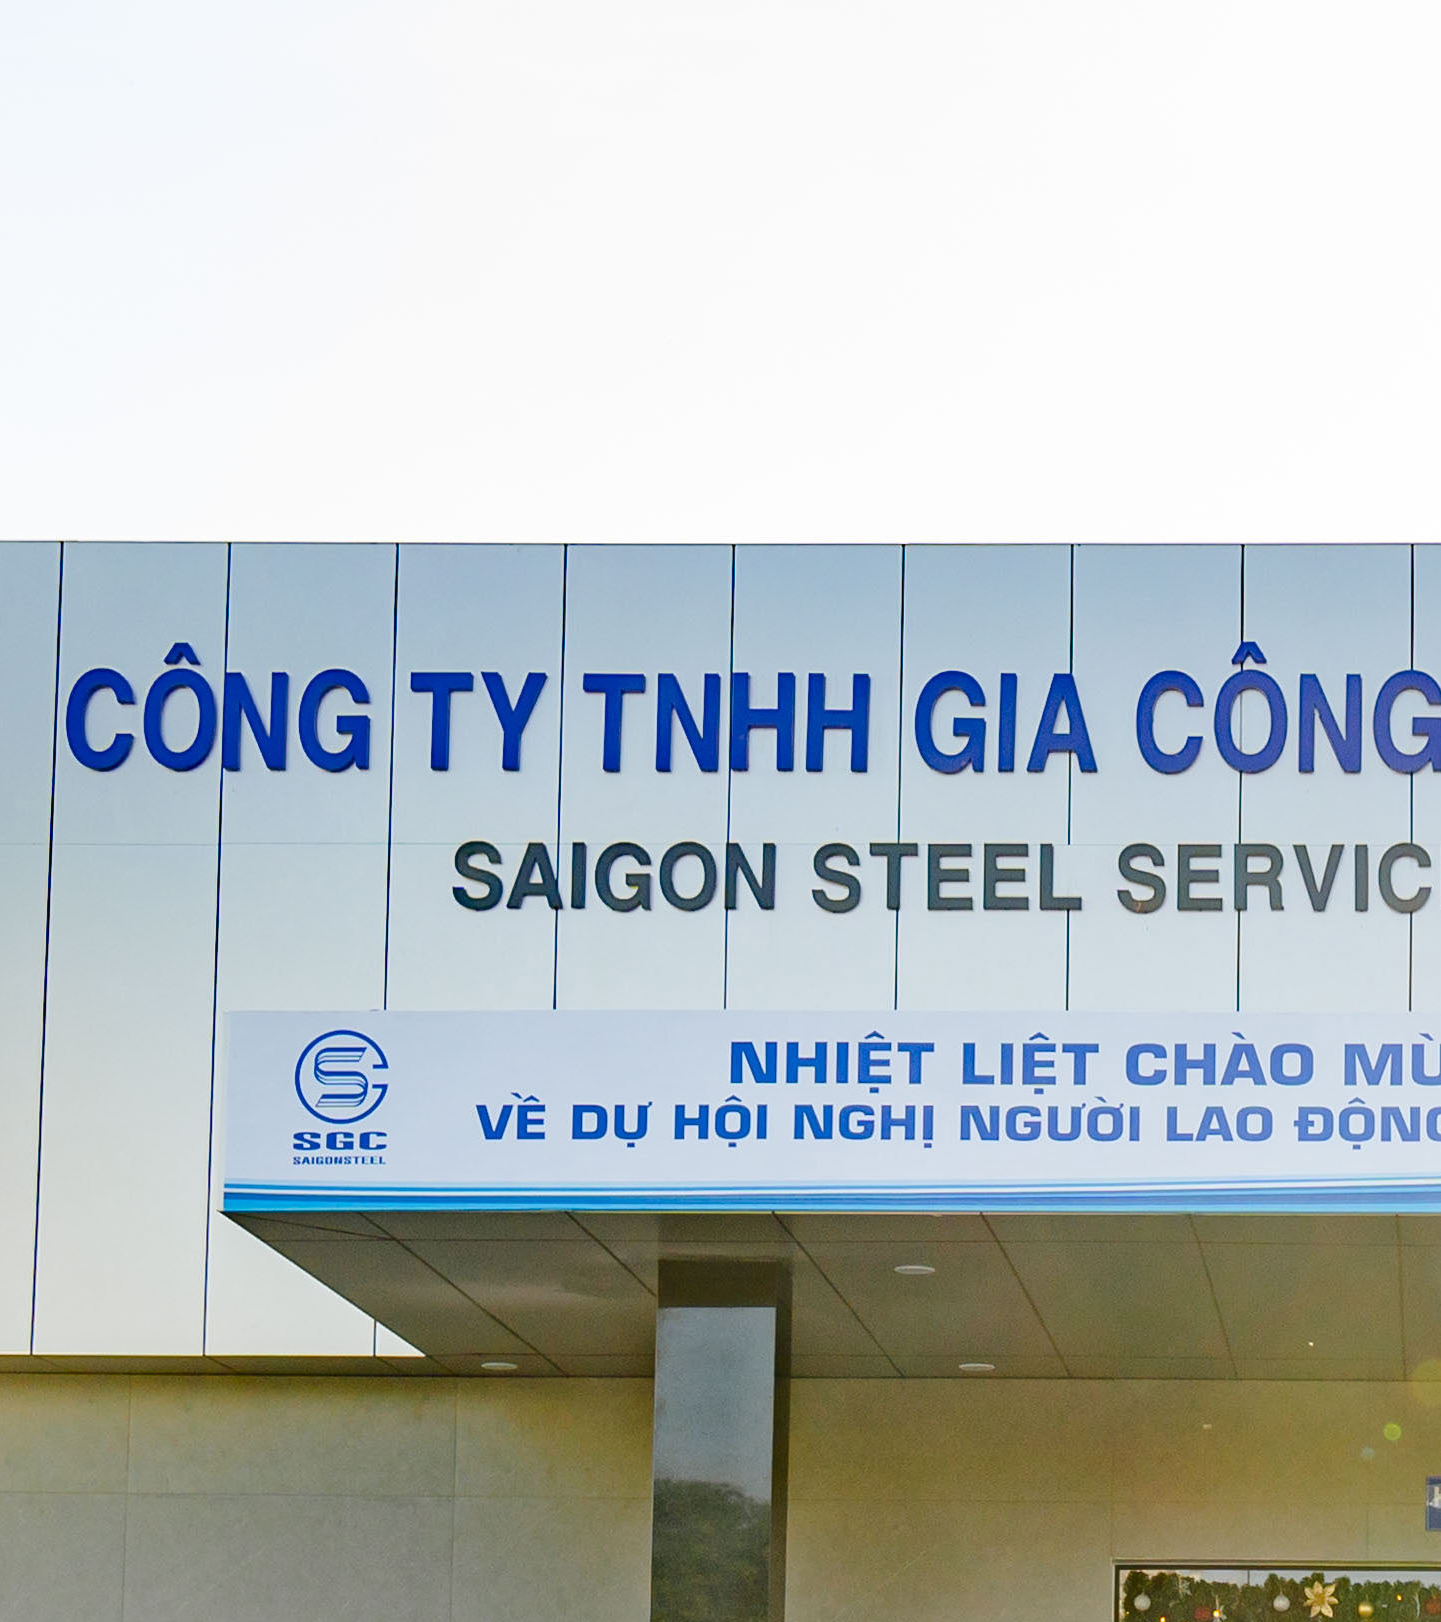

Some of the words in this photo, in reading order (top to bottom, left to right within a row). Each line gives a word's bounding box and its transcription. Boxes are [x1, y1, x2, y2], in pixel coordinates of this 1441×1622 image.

[66, 642, 374, 775] CÔNG
[410, 671, 550, 773] TY
[583, 671, 873, 775] TNHH
[915, 670, 1099, 776] GIA
[452, 840, 778, 914] SAIGON
[811, 841, 1084, 915] STEEL
[730, 1032, 937, 1094] NHIỆT
[962, 1033, 1101, 1095] LIỆT
[1126, 1032, 1316, 1087] CHÀO
[292, 1131, 388, 1151] SGC
[475, 1092, 547, 1141] VỀ
[571, 1101, 653, 1149] DỰ
[673, 1095, 769, 1149] HỘI
[793, 1104, 935, 1149] NGHỊ
[959, 1097, 1141, 1142] NGƯỜI
[1166, 1105, 1274, 1142] LAO
[292, 1156, 387, 1166] SAIGONSTEEL
